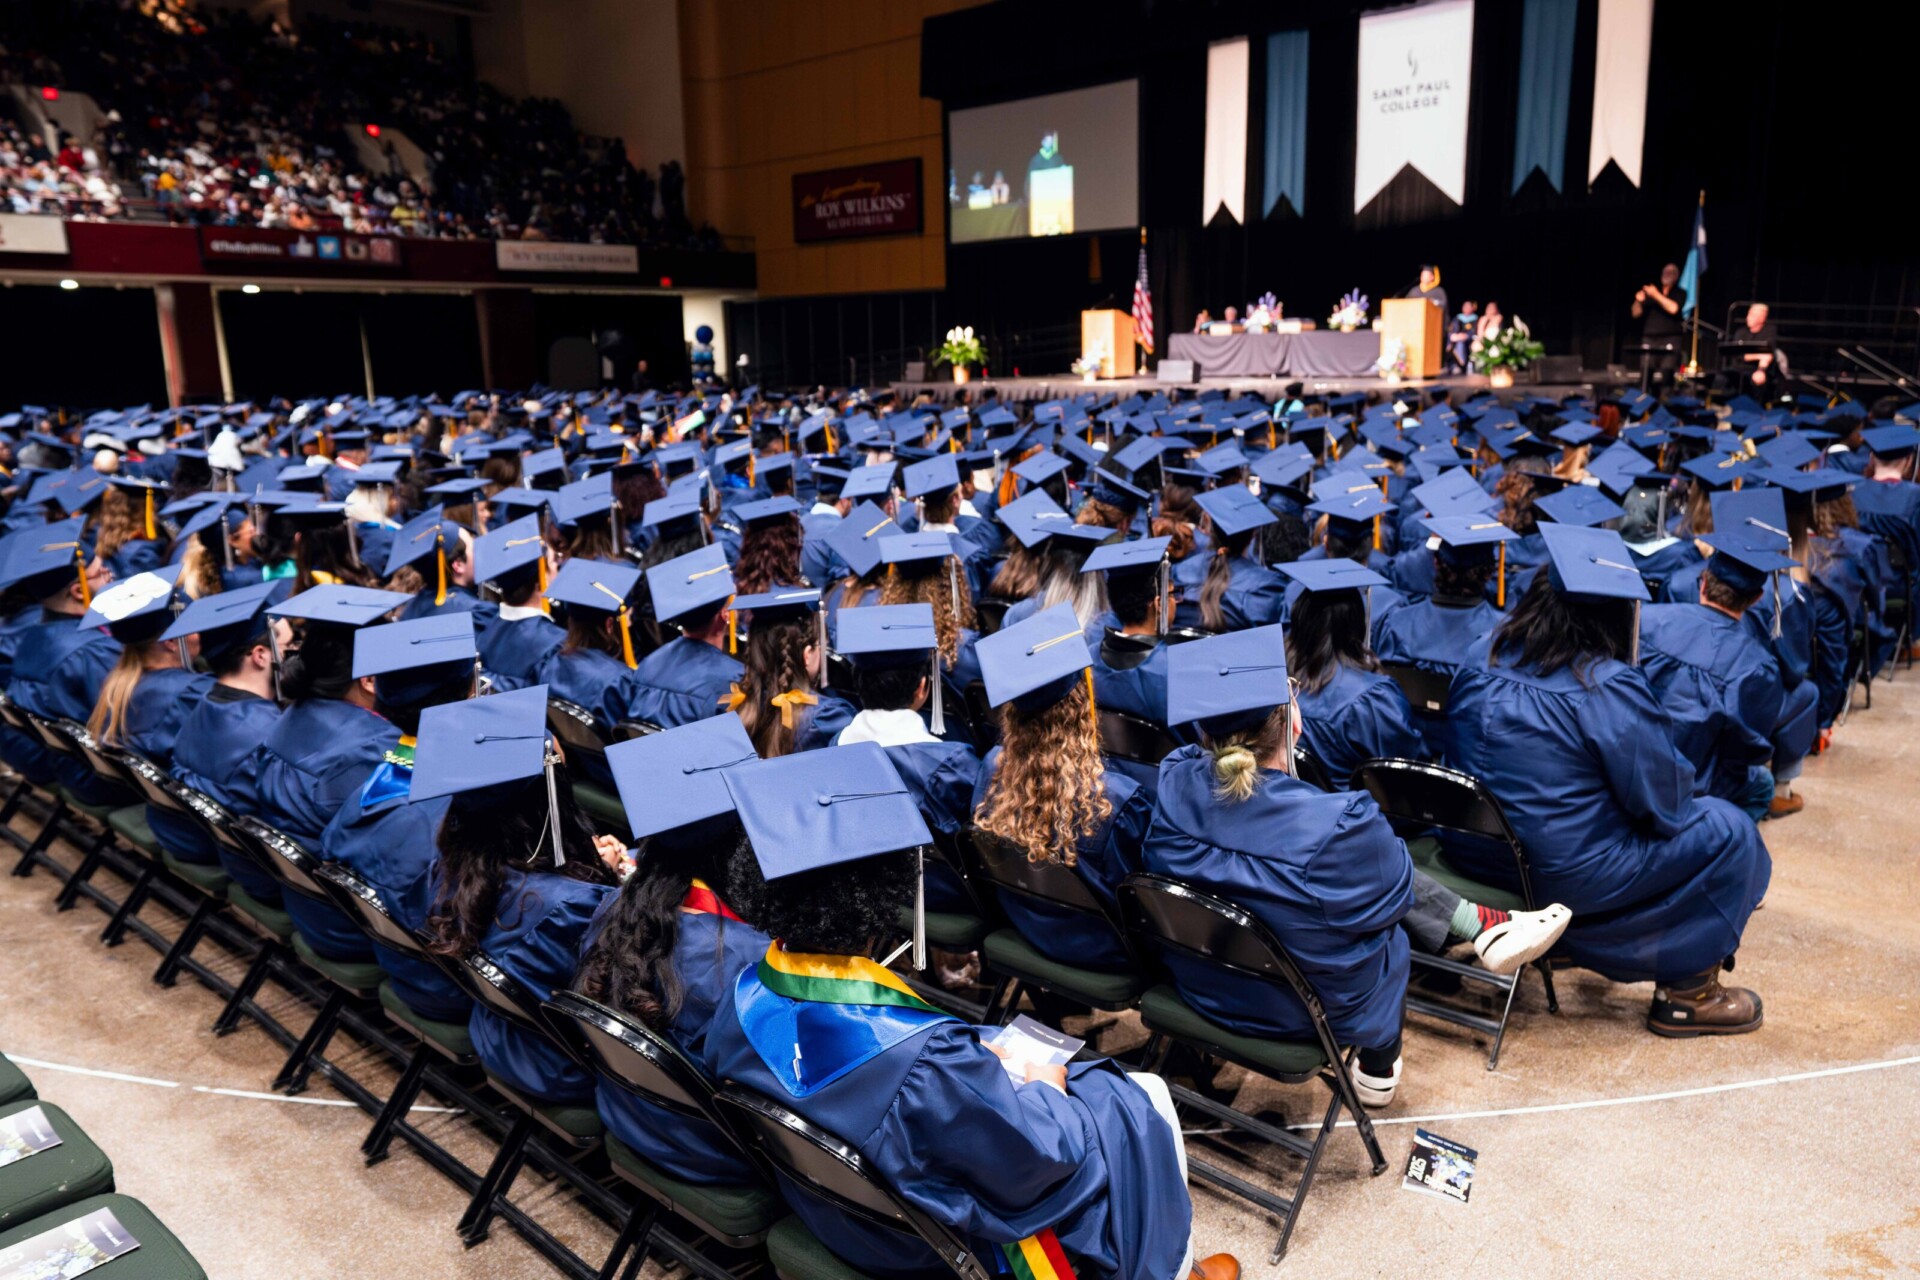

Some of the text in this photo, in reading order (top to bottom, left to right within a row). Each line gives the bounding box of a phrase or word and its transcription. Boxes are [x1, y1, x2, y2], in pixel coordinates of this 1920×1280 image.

[1373, 80, 1451, 101] SAINT PAUL
[1380, 95, 1439, 113] COLLEGE
[843, 193, 905, 213] WILKINS
[1408, 1156, 1427, 1181] 2025
